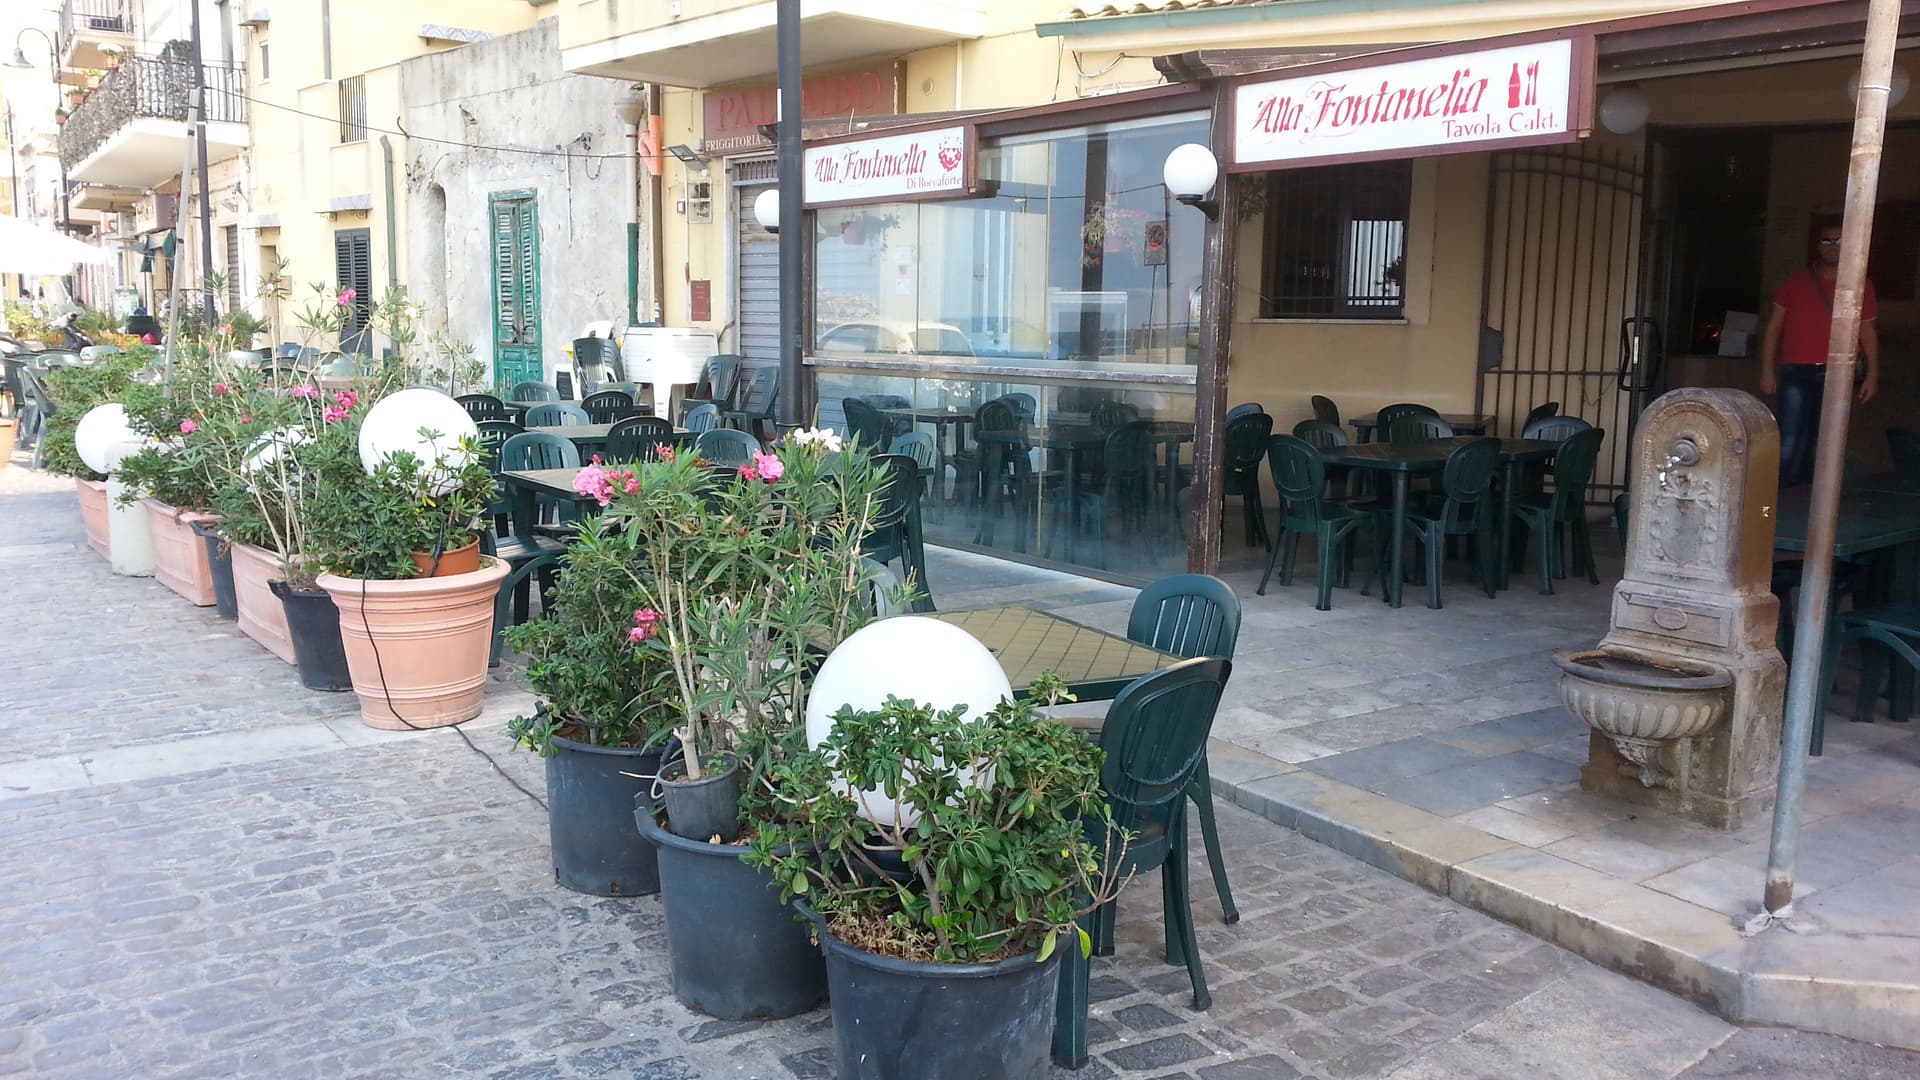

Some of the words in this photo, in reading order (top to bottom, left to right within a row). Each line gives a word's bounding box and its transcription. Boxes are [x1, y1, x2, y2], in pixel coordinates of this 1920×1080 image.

[1252, 95, 1304, 134] Alla
[1442, 113, 1501, 138] Tavola
[705, 134, 761, 152] FRIGGITORIA
[815, 156, 839, 183] Alla
[839, 143, 927, 184] Fontanella
[906, 177, 917, 190] Di
[918, 173, 962, 188] Roccaforte
